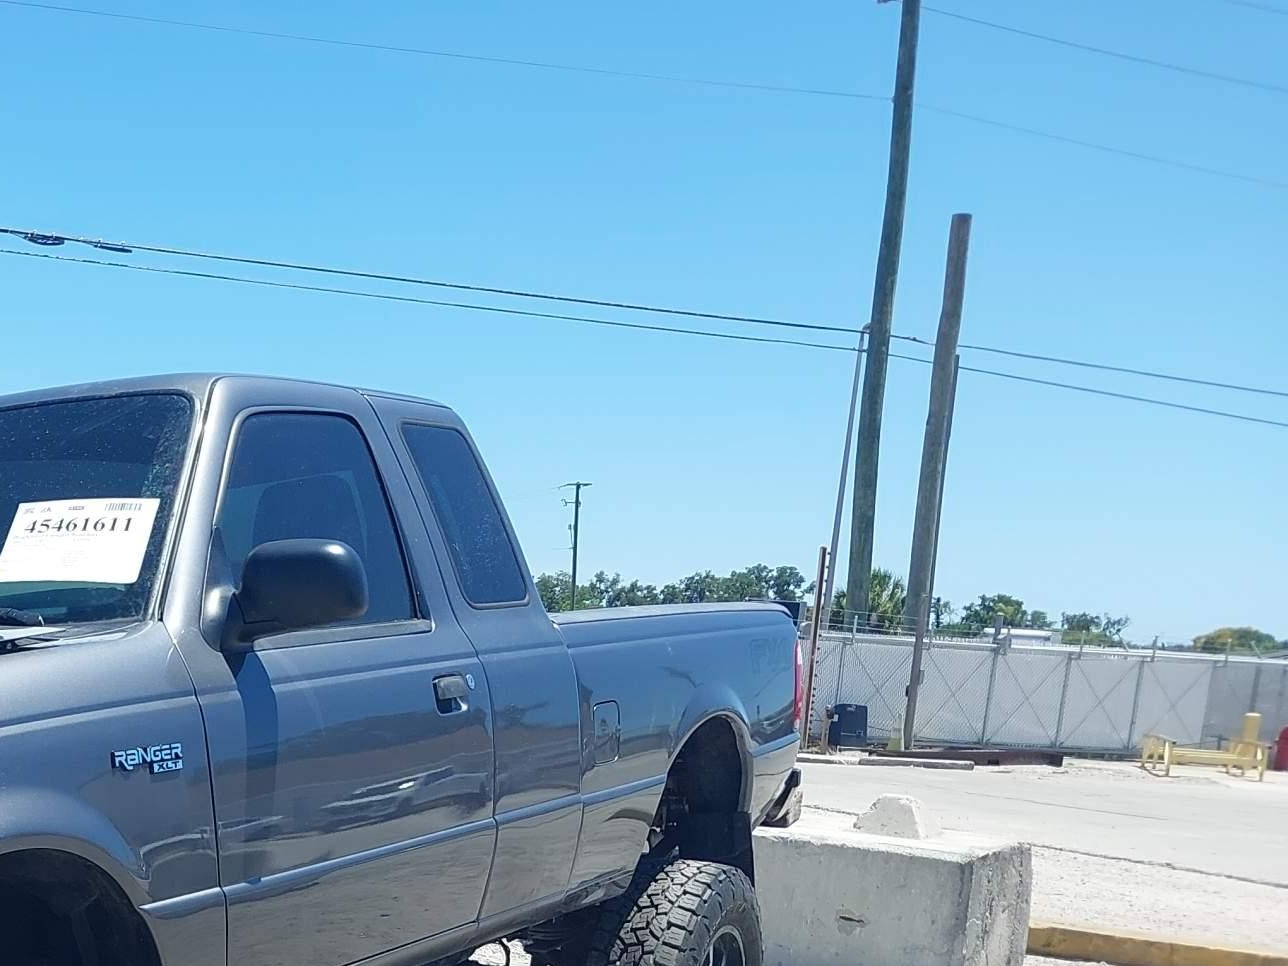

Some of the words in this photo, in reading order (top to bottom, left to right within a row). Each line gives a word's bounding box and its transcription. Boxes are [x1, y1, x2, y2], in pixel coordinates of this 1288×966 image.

[23, 516, 134, 534] 45461611
[114, 743, 183, 770] RANGER
[155, 760, 181, 772] XLT
